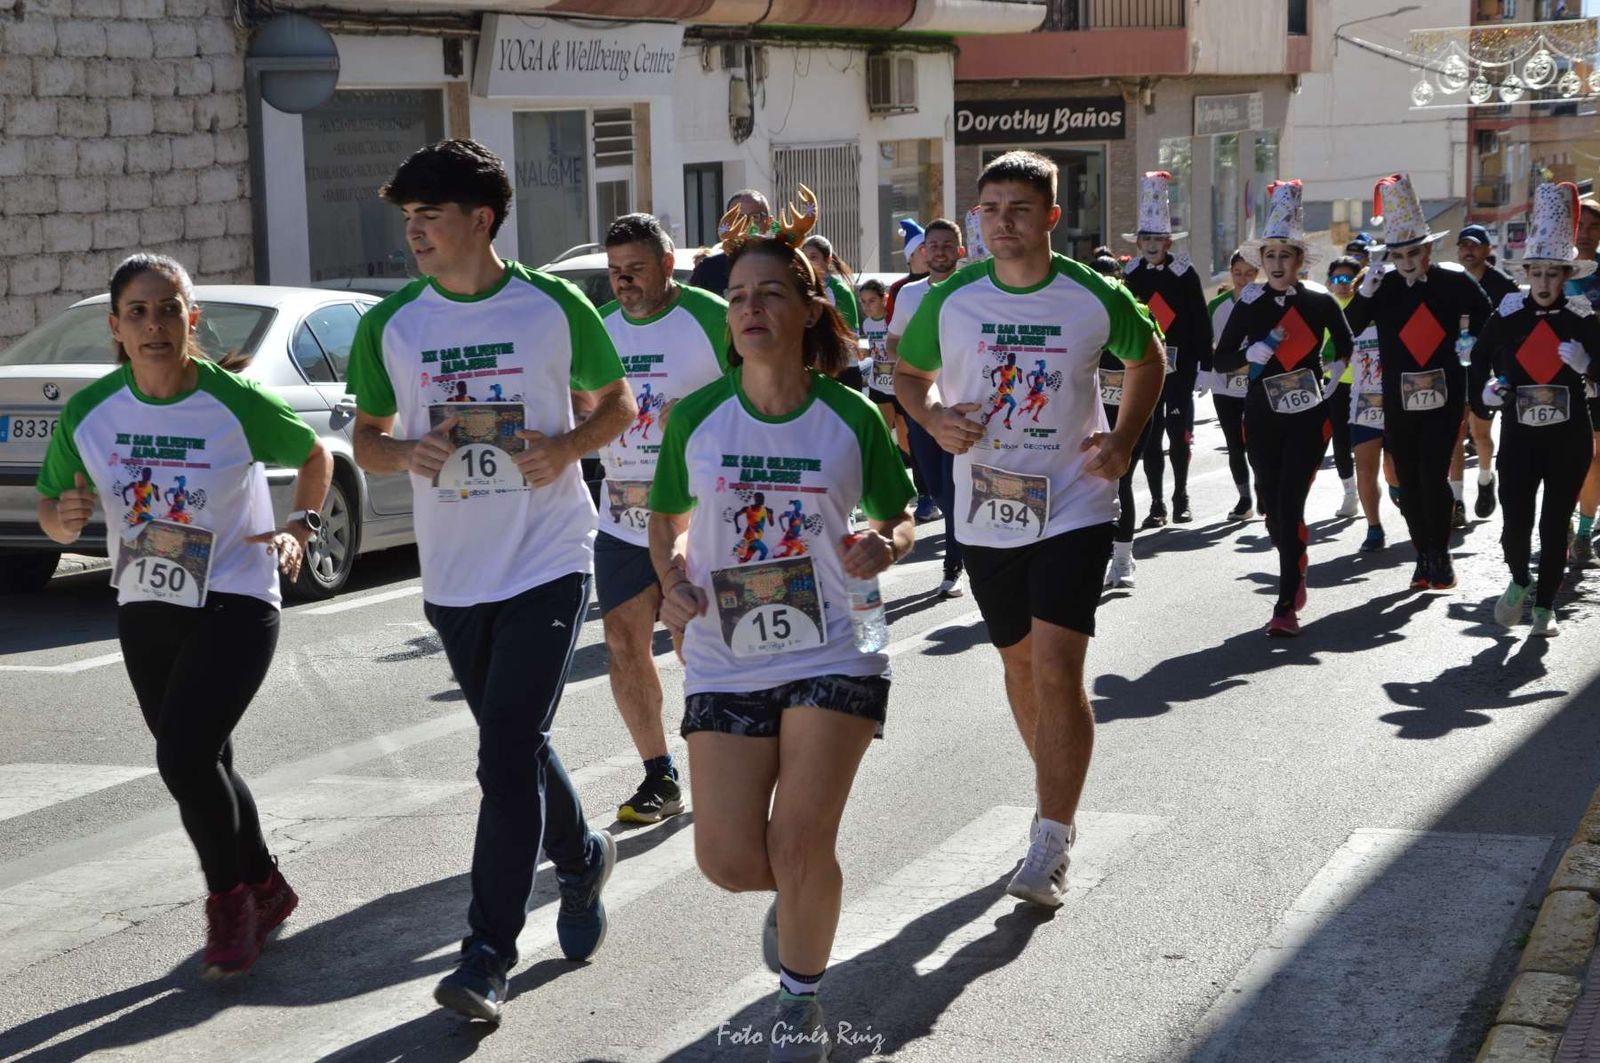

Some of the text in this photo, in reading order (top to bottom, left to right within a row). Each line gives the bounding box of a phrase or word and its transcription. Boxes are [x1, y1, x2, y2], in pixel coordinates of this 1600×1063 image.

[499, 39, 676, 81] YOGA & Wellbeing Centre
[957, 107, 1122, 135] Dorothy Baños
[998, 323, 1016, 335] SAN
[1282, 390, 1310, 410] 166
[1412, 390, 1436, 405] 171
[1529, 407, 1557, 422] 167
[461, 449, 497, 478] 16
[624, 510, 650, 528] 19
[987, 500, 1030, 528] 194
[135, 558, 186, 592] 150
[752, 609, 791, 641] 15
